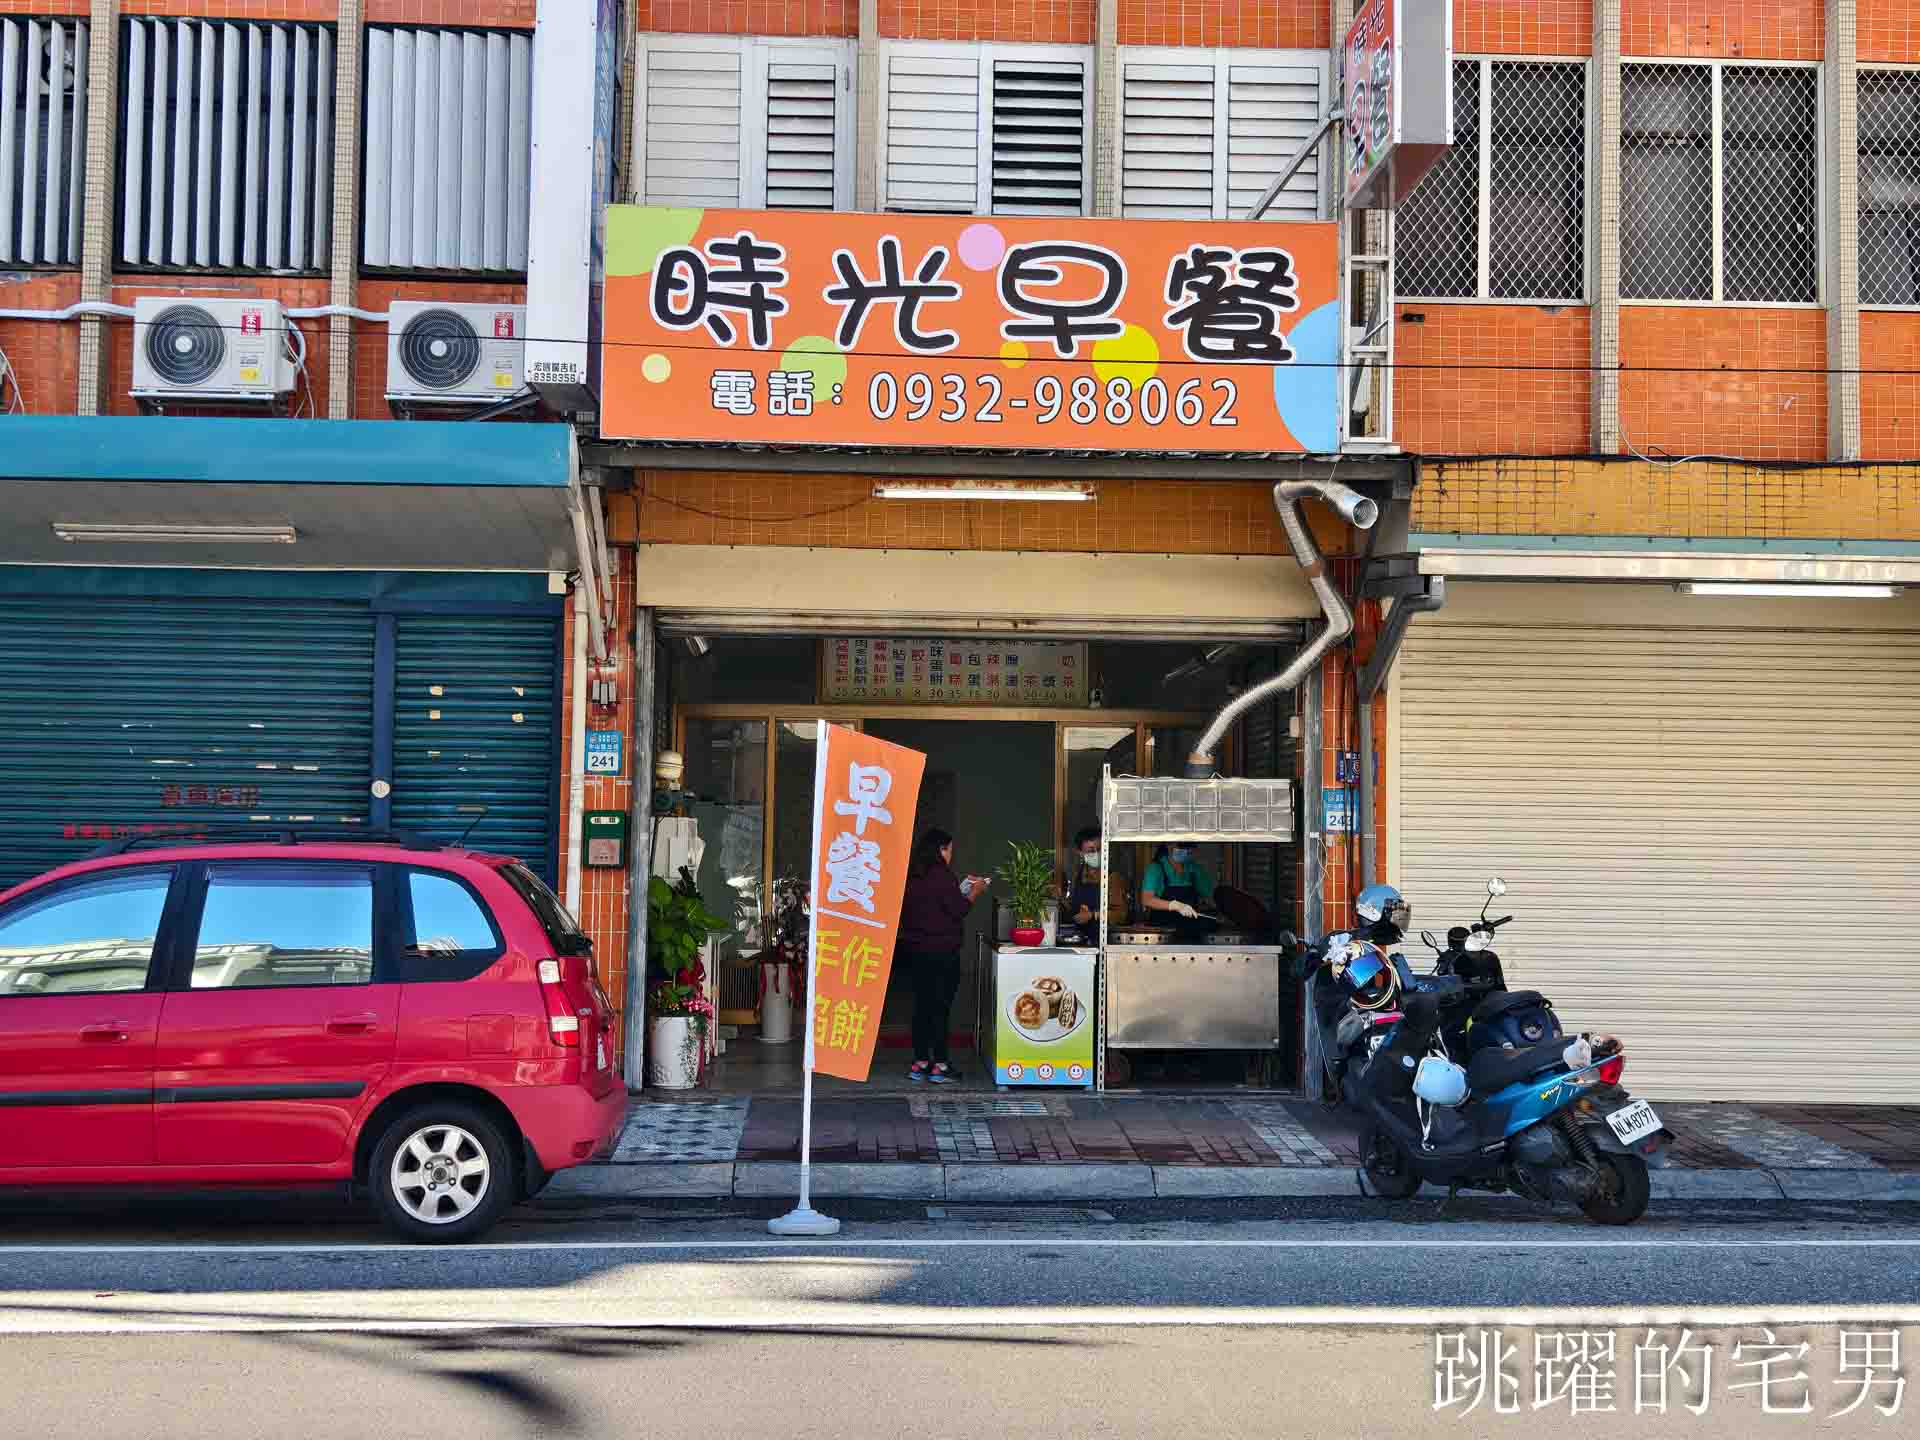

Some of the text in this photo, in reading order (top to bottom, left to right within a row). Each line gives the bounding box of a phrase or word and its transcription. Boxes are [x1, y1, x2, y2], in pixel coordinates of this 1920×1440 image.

[650, 231, 1301, 364] 時光早餐
[867, 369, 1240, 428] 0932-988062
[591, 756, 614, 767] 241
[826, 760, 893, 913] 早餐
